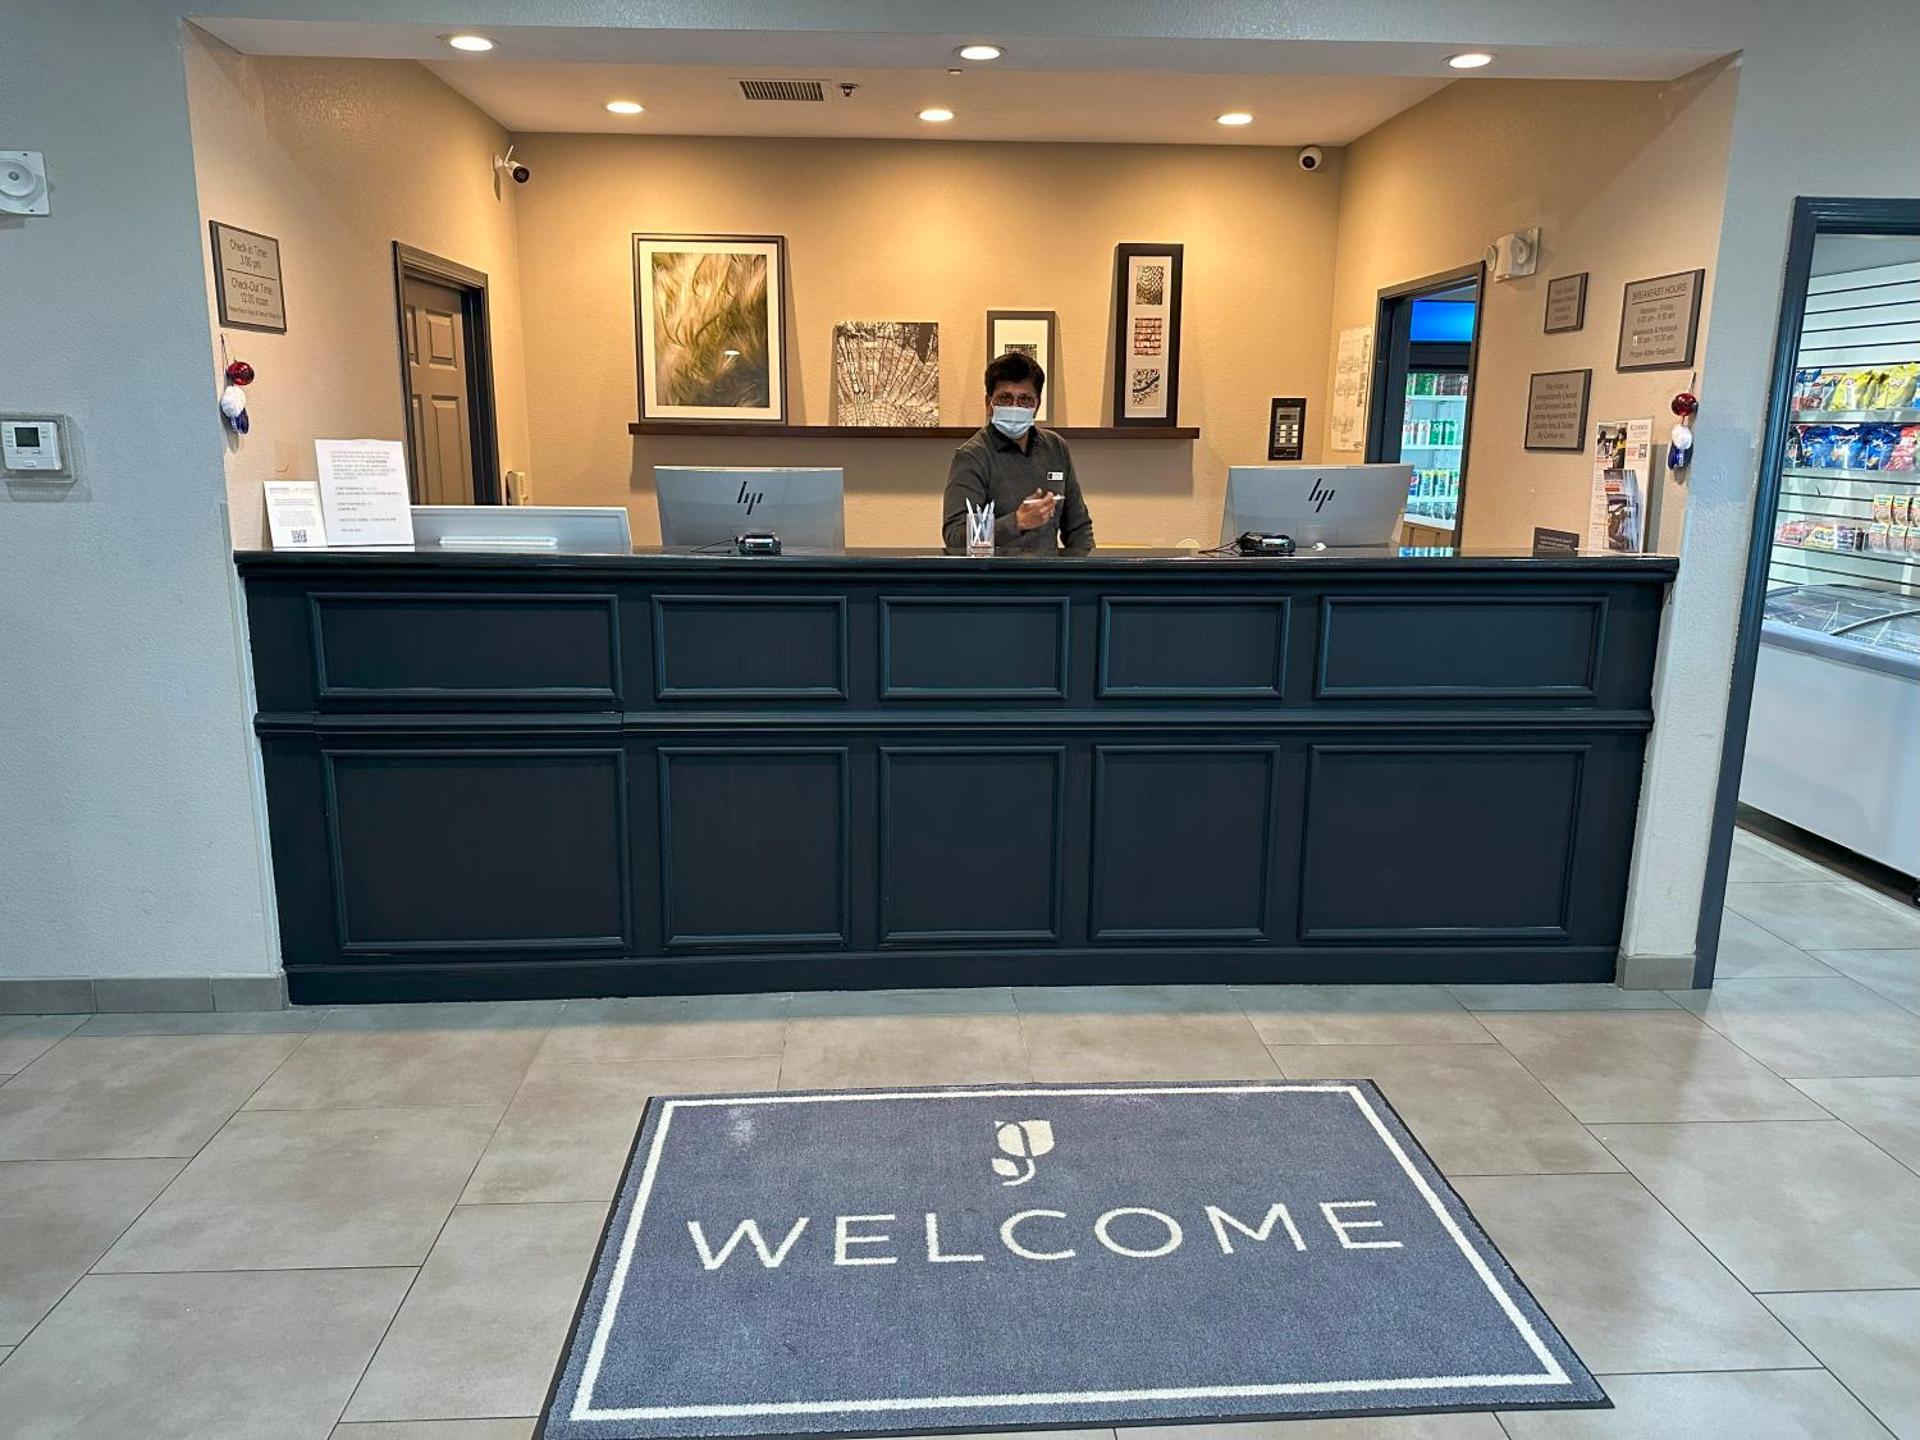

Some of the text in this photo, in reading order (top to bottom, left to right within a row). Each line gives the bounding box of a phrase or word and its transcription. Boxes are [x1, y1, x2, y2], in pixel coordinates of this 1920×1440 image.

[1665, 282, 1687, 294] HOURS
[737, 480, 764, 515] hp
[1308, 478, 1336, 513] hp
[687, 1199, 1404, 1271] WELCOME
